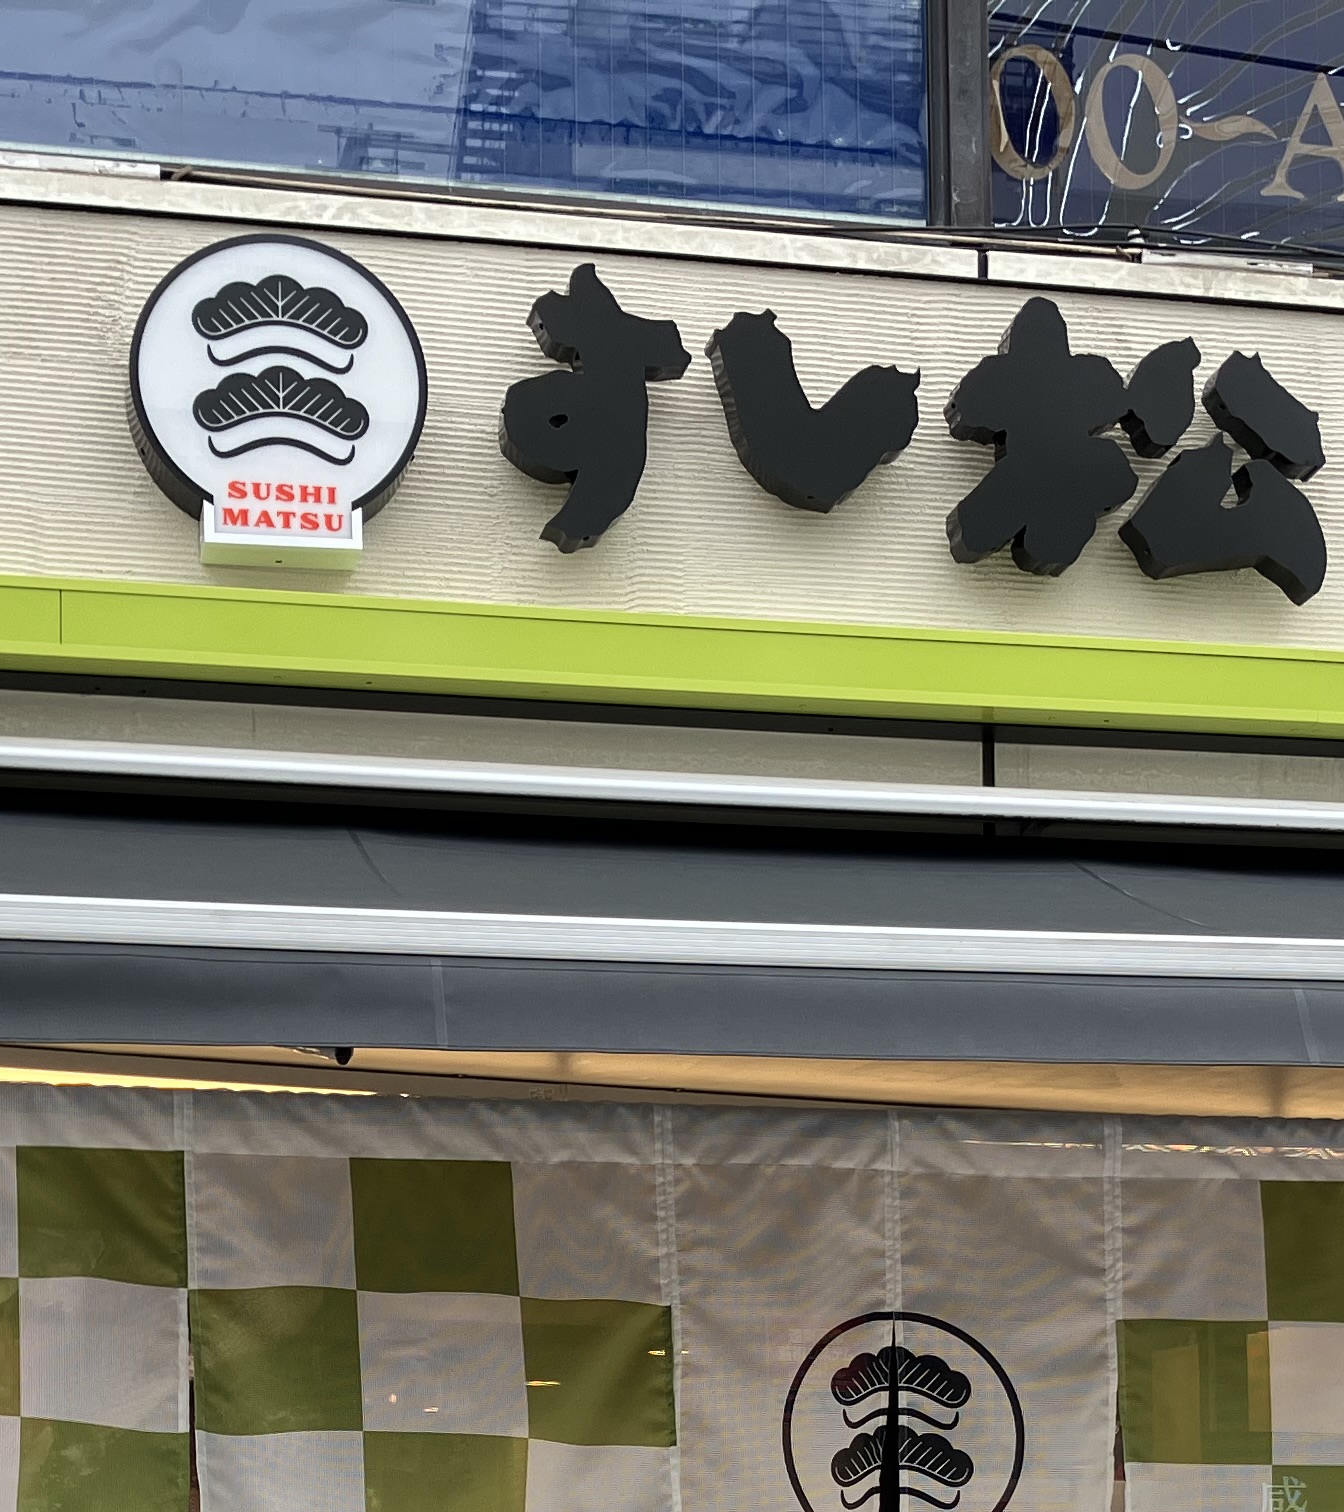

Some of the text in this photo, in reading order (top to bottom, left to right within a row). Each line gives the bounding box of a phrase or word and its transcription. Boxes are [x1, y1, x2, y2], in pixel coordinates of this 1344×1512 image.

[499, 263, 1328, 605] すし松
[225, 480, 339, 505] SUSHI
[220, 508, 346, 533] MATSU
